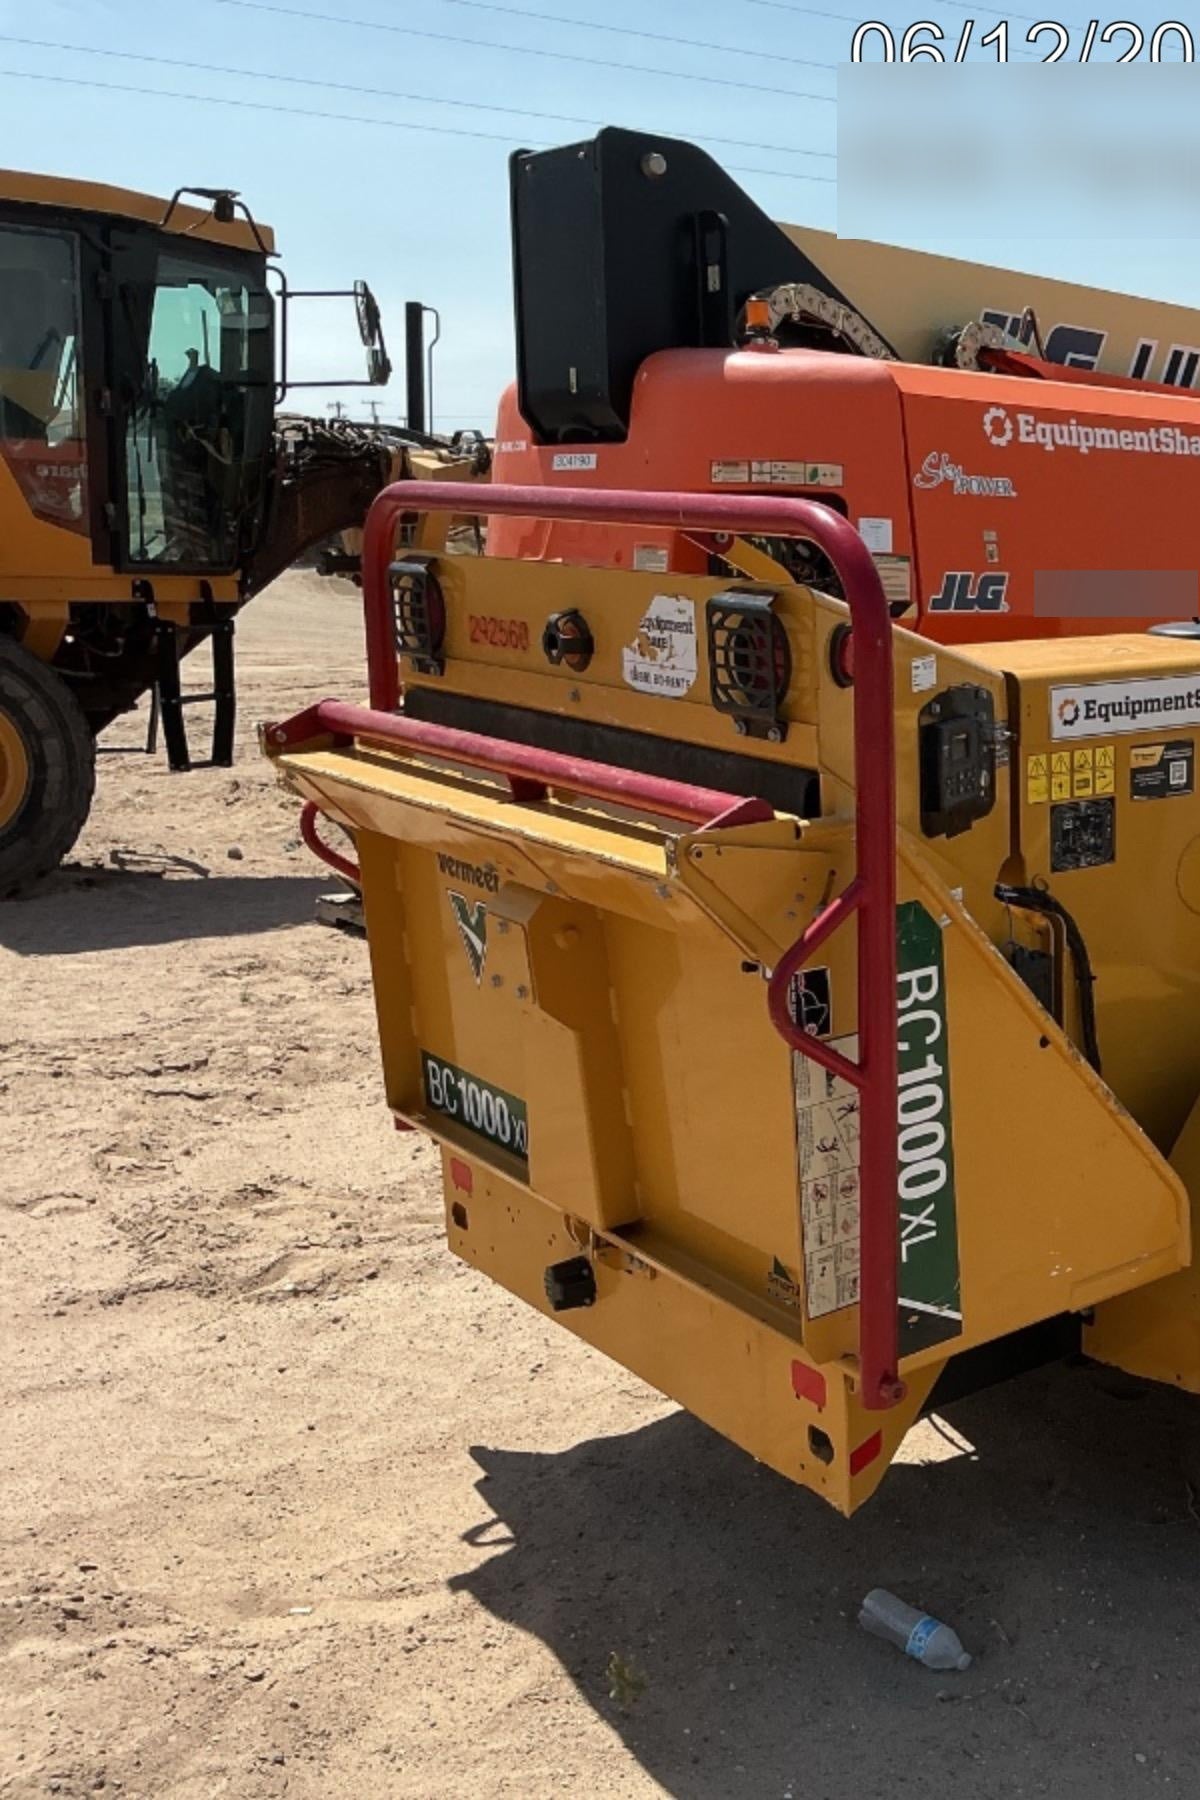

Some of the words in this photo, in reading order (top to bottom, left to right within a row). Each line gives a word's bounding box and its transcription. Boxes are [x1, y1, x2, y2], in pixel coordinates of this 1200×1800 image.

[929, 571, 1008, 613] JLG
[469, 614, 529, 652] 292560
[899, 1203, 937, 1263] XL
